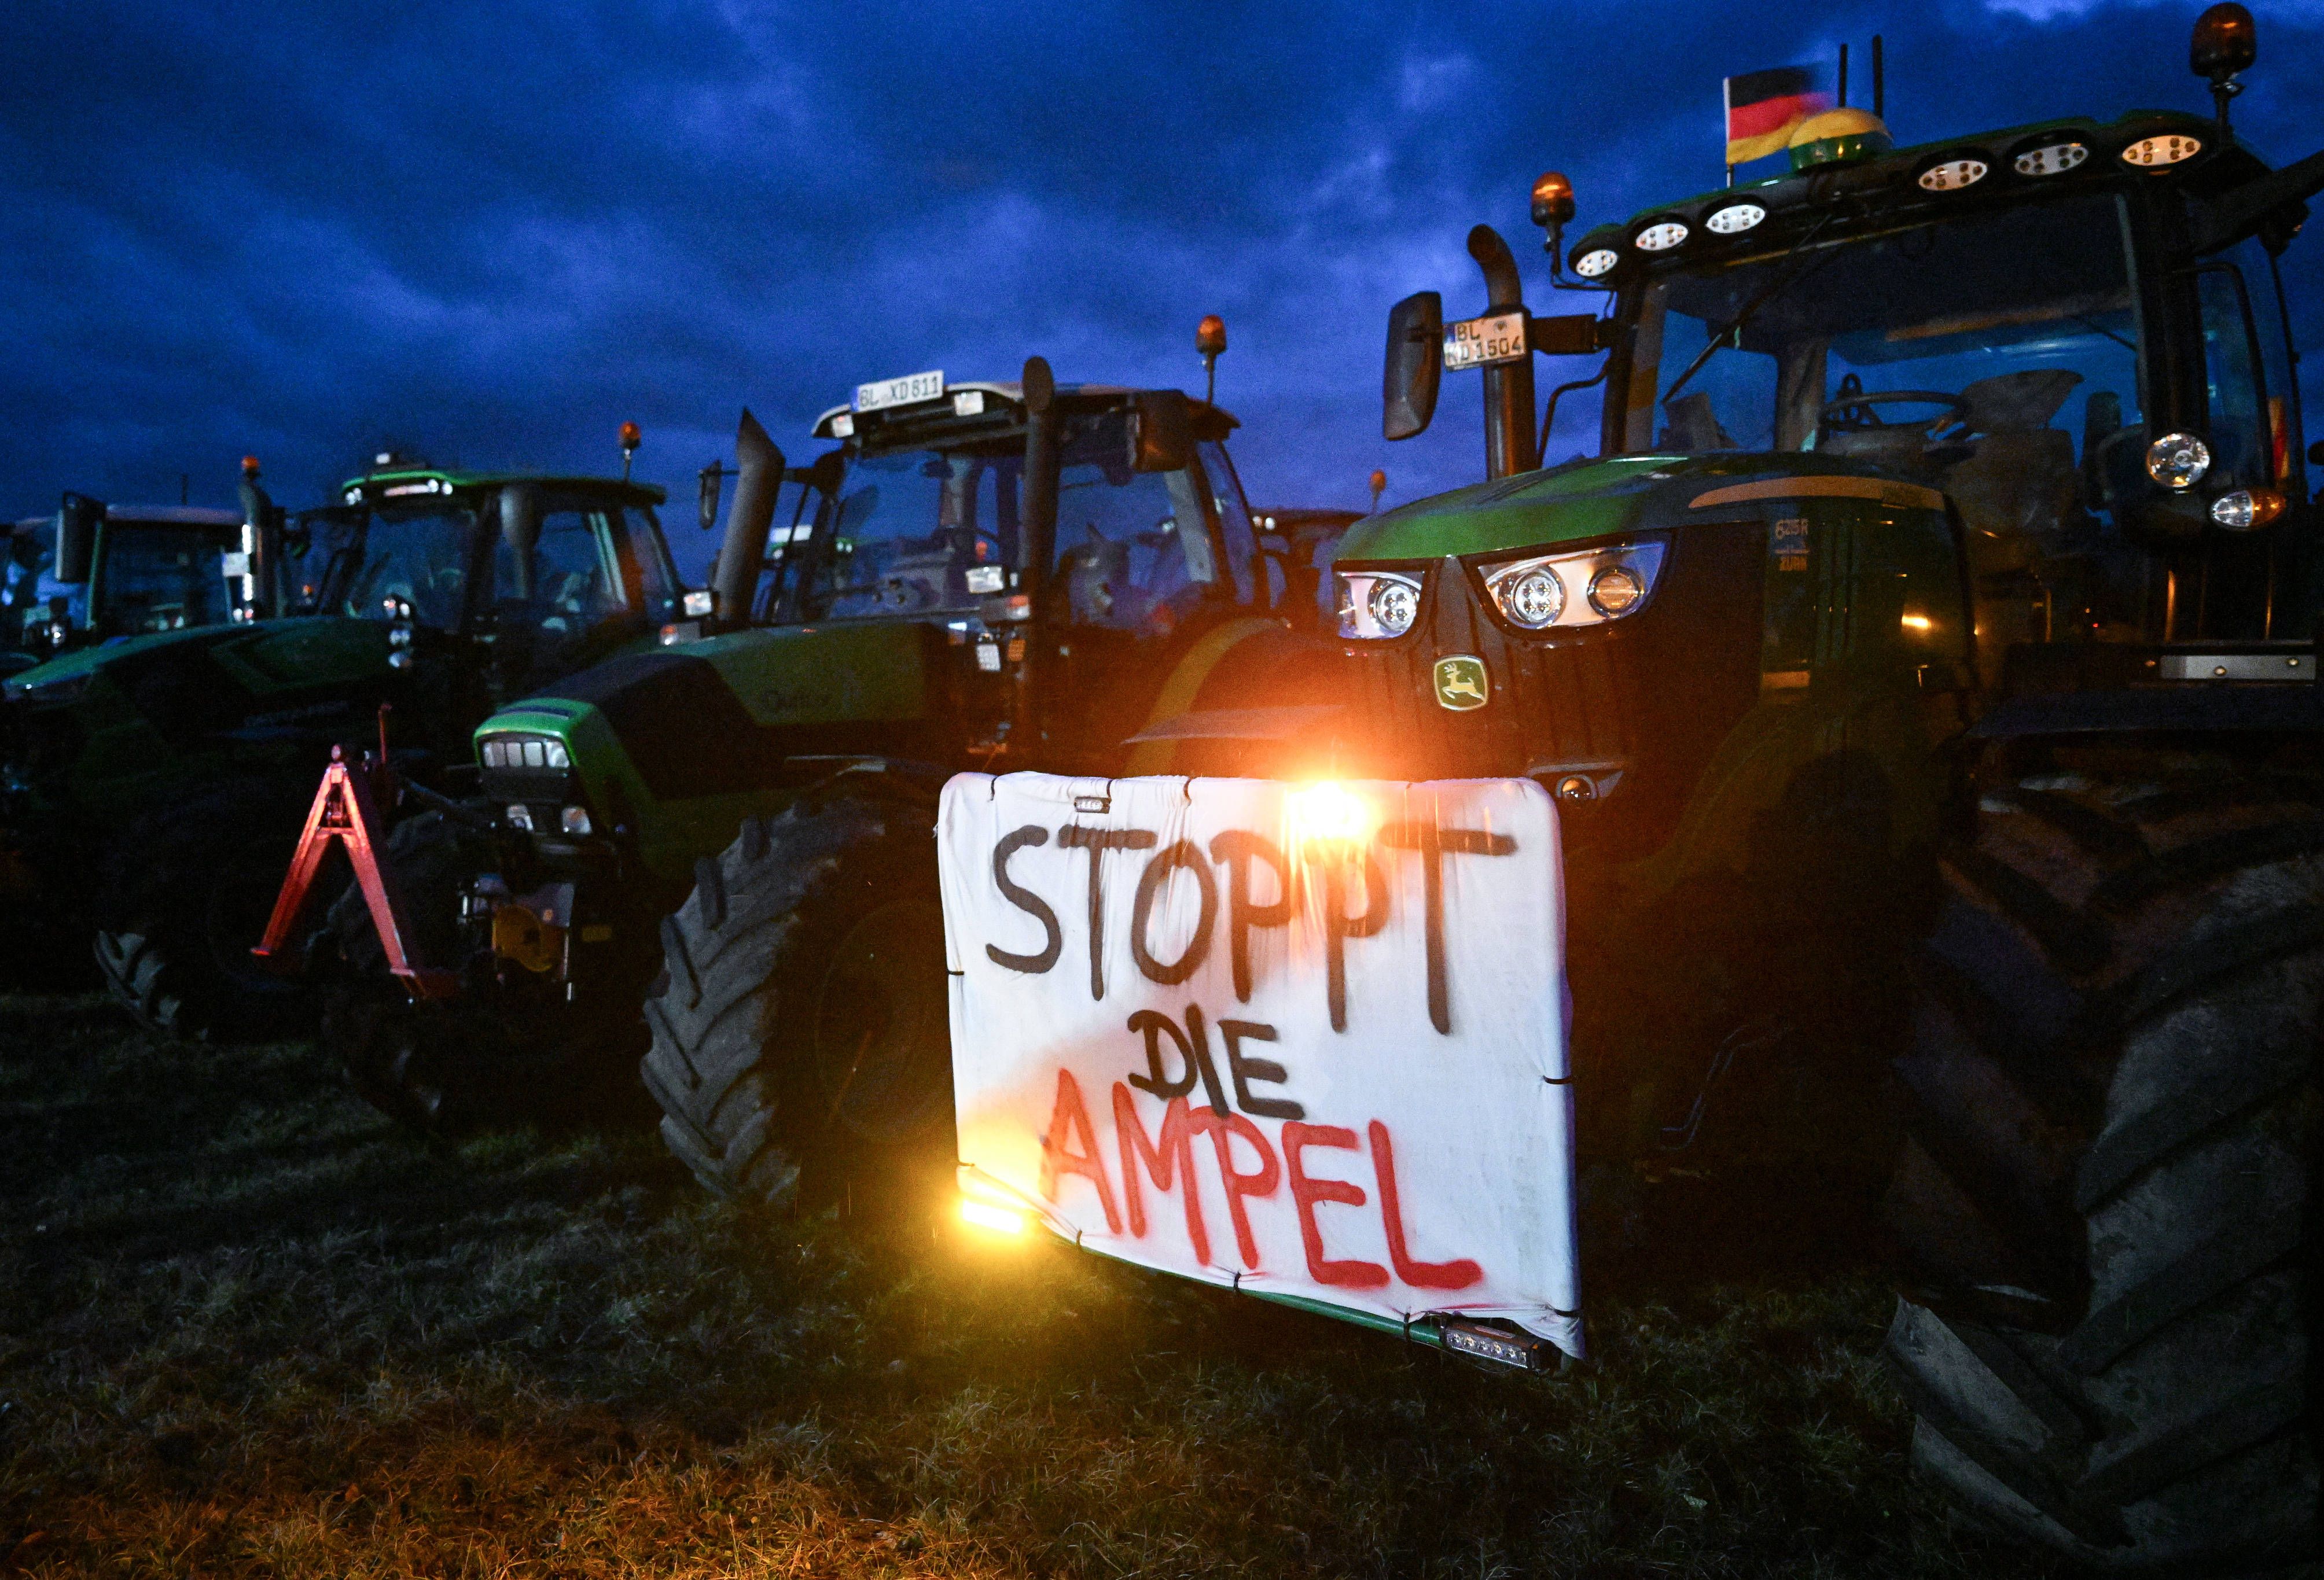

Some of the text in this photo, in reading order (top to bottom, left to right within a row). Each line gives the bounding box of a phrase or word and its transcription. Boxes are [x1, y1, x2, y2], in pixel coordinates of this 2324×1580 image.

[1457, 323, 1480, 341] BL
[859, 388, 878, 407] BL
[985, 824, 1518, 1035] STOPPT
[1127, 1003, 1306, 1119] DIE
[1040, 1067, 1483, 1289] AMPEL
